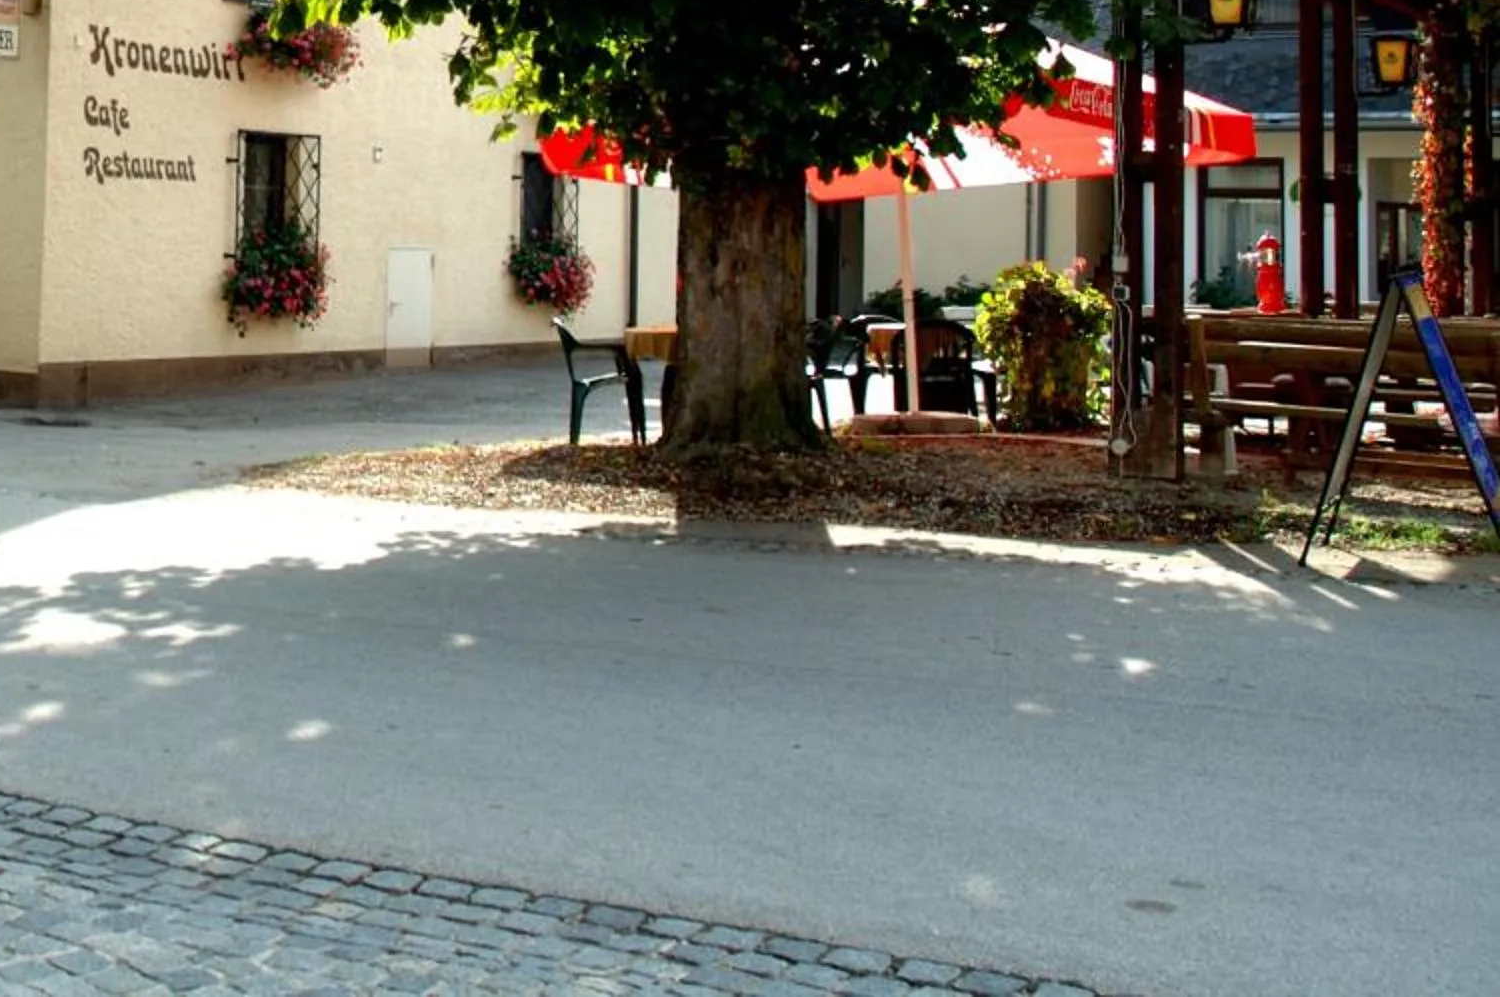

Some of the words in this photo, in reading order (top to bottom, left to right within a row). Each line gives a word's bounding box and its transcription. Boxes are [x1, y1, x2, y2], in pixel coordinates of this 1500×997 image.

[88, 23, 245, 82] Kronenwirt
[83, 95, 130, 137] Cafe
[83, 146, 197, 185] Restaurant
